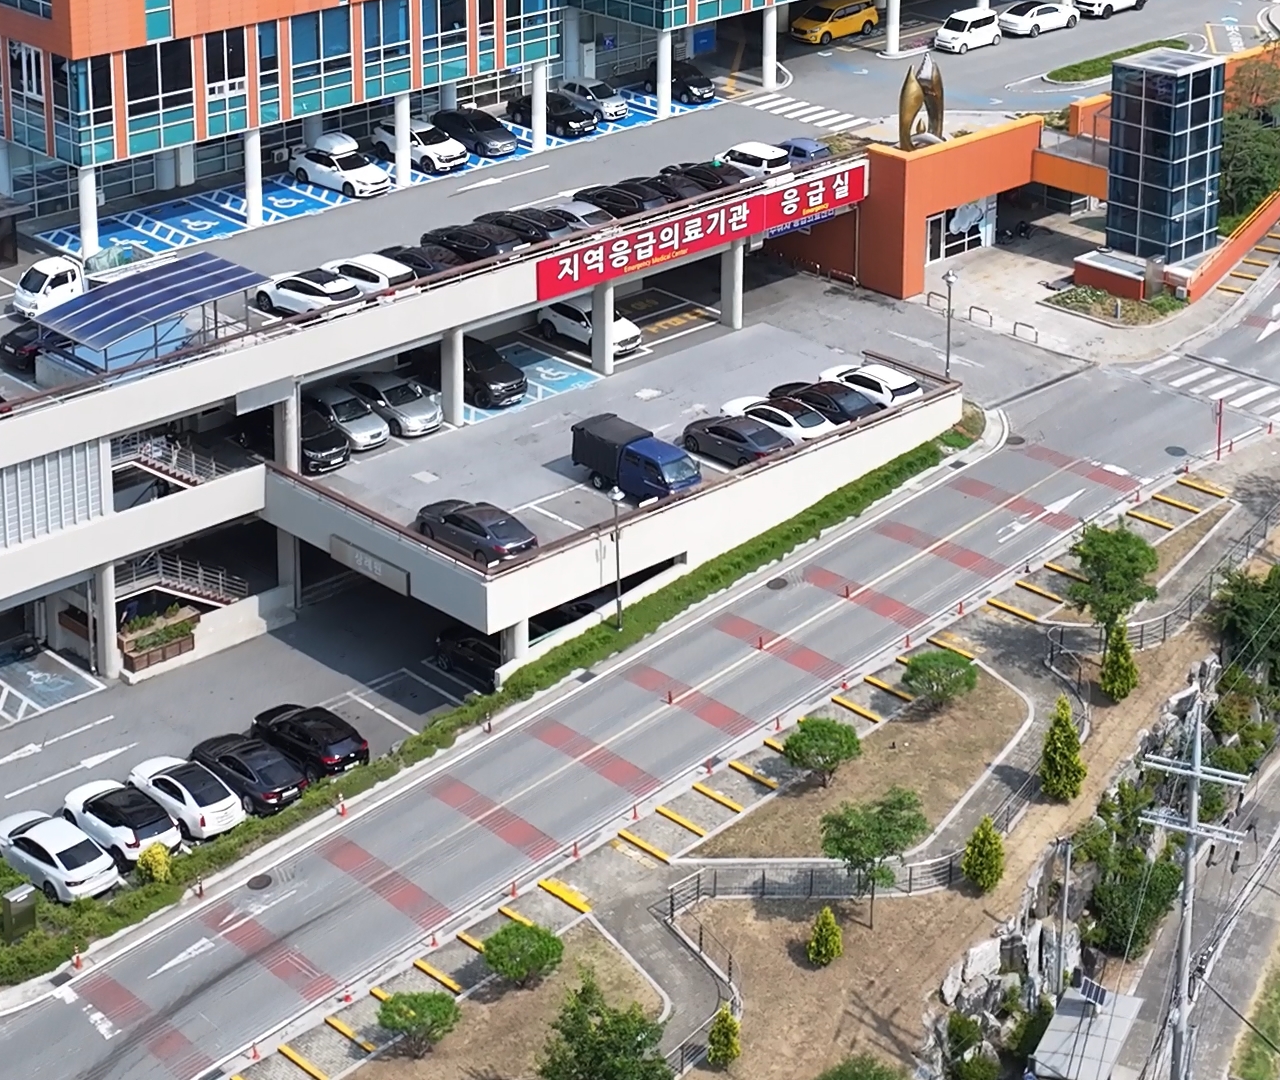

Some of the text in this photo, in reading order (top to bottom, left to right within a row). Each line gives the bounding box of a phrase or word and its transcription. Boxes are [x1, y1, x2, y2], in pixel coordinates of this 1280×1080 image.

[557, 202, 749, 281] 지역응급의료기관
[623, 248, 689, 273] Emergency Medical Center
